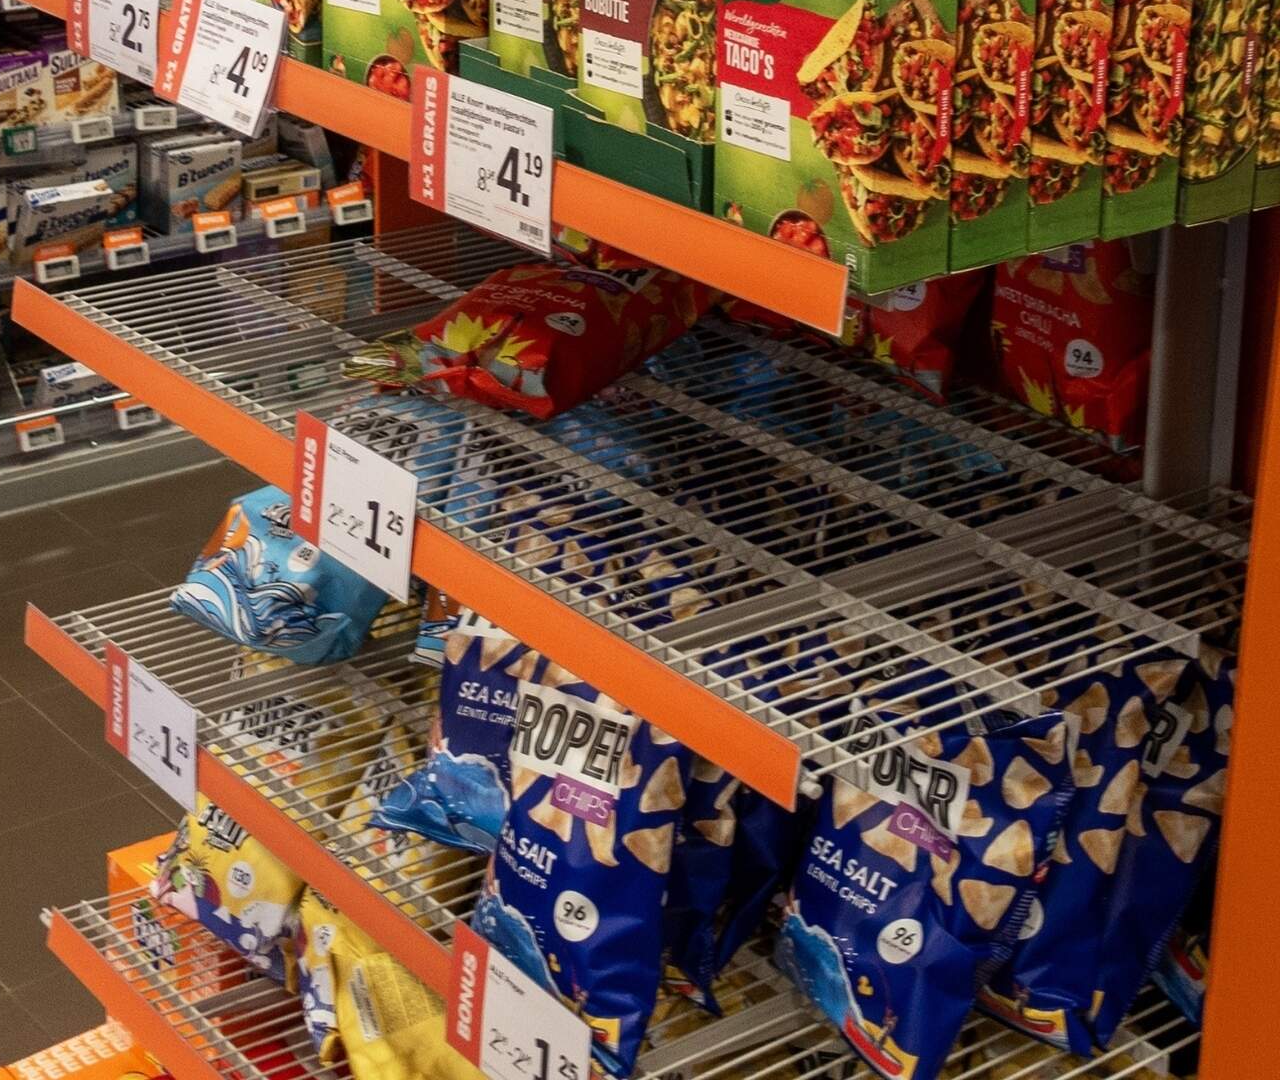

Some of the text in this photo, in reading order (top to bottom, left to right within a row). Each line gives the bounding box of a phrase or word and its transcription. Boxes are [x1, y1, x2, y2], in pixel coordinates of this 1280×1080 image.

[724, 39, 775, 81] TACO'S
[1175, 51, 1185, 98] OPEN HIER
[423, 76, 438, 158] GRATIS
[996, 286, 1081, 329] WEET SRIRACHA
[1072, 349, 1095, 366] 94
[299, 436, 319, 524] BONUS
[365, 499, 404, 560] 1.25
[111, 664, 124, 739] BONUS
[457, 704, 486, 720] LENTIL
[458, 680, 488, 706] SEA
[553, 782, 613, 822] CHIPS
[516, 836, 558, 877] SALT
[810, 834, 899, 904] SEA SALT
[806, 862, 879, 916] LENTIL CHIPS
[561, 899, 587, 923] 96
[893, 926, 914, 947] 96
[458, 950, 480, 1042] BONUS
